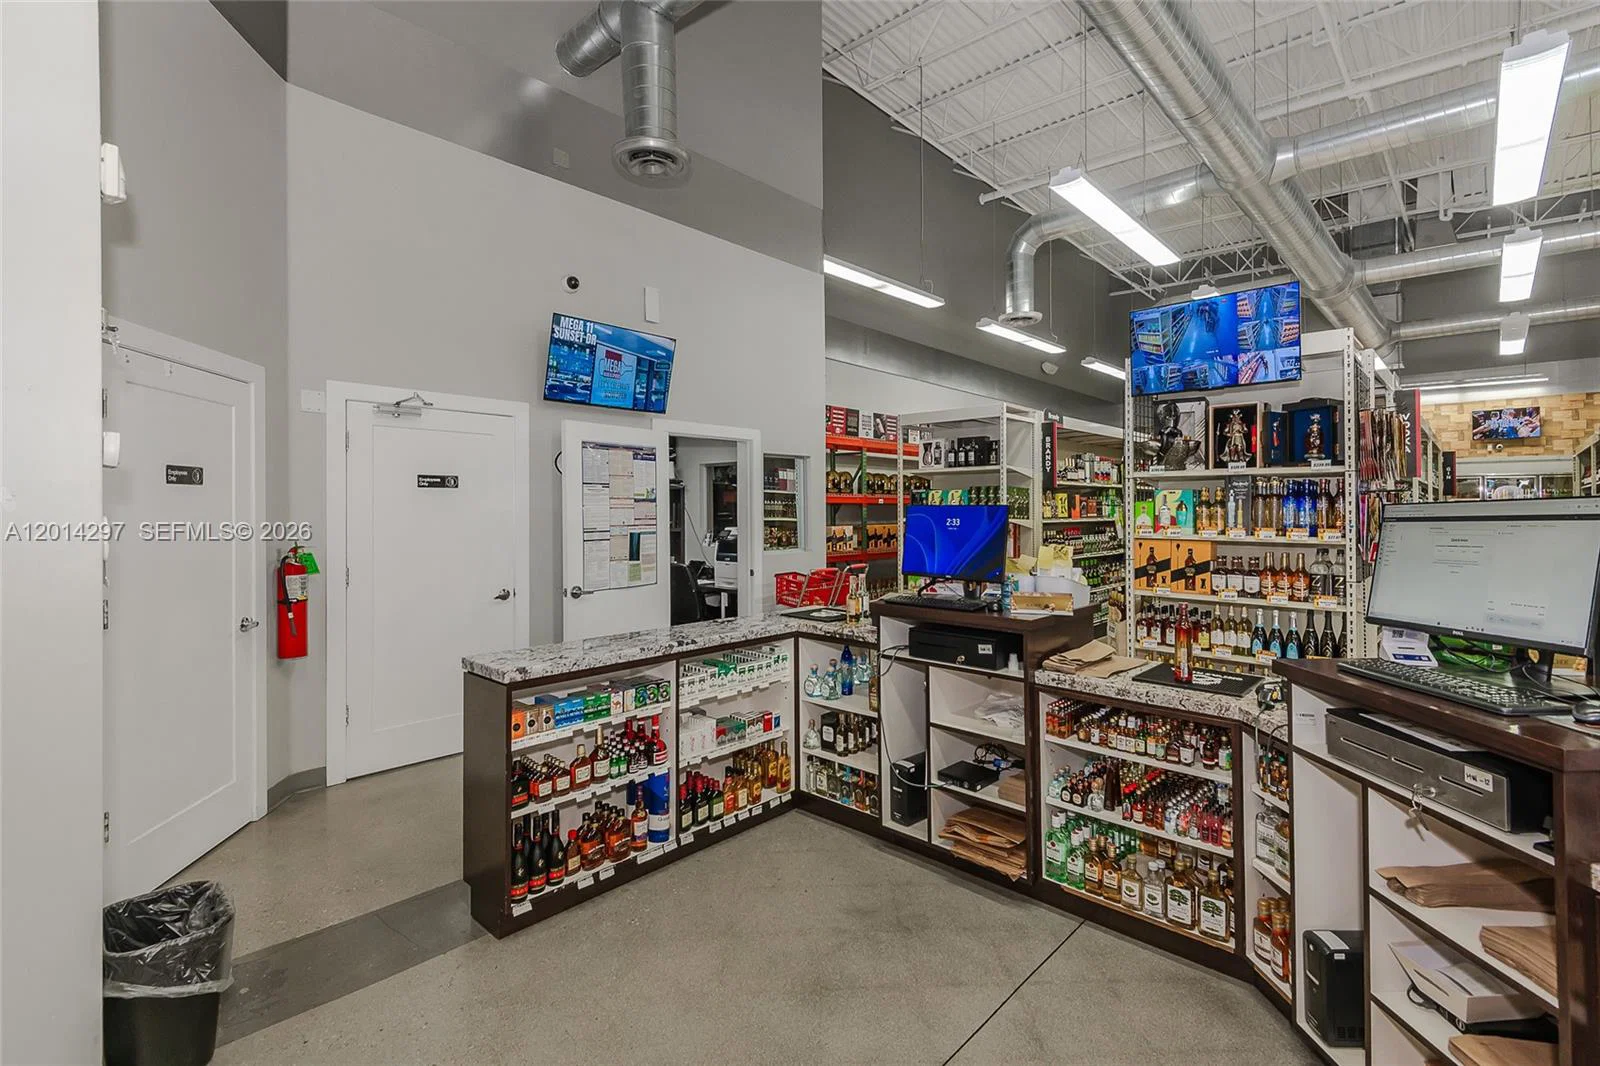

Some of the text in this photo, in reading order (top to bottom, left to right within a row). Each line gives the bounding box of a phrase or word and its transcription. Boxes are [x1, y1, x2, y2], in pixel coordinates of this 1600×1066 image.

[560, 317, 594, 333] MEGA 11
[553, 326, 597, 345] SUNSET DR
[946, 518, 960, 526] 2:33
